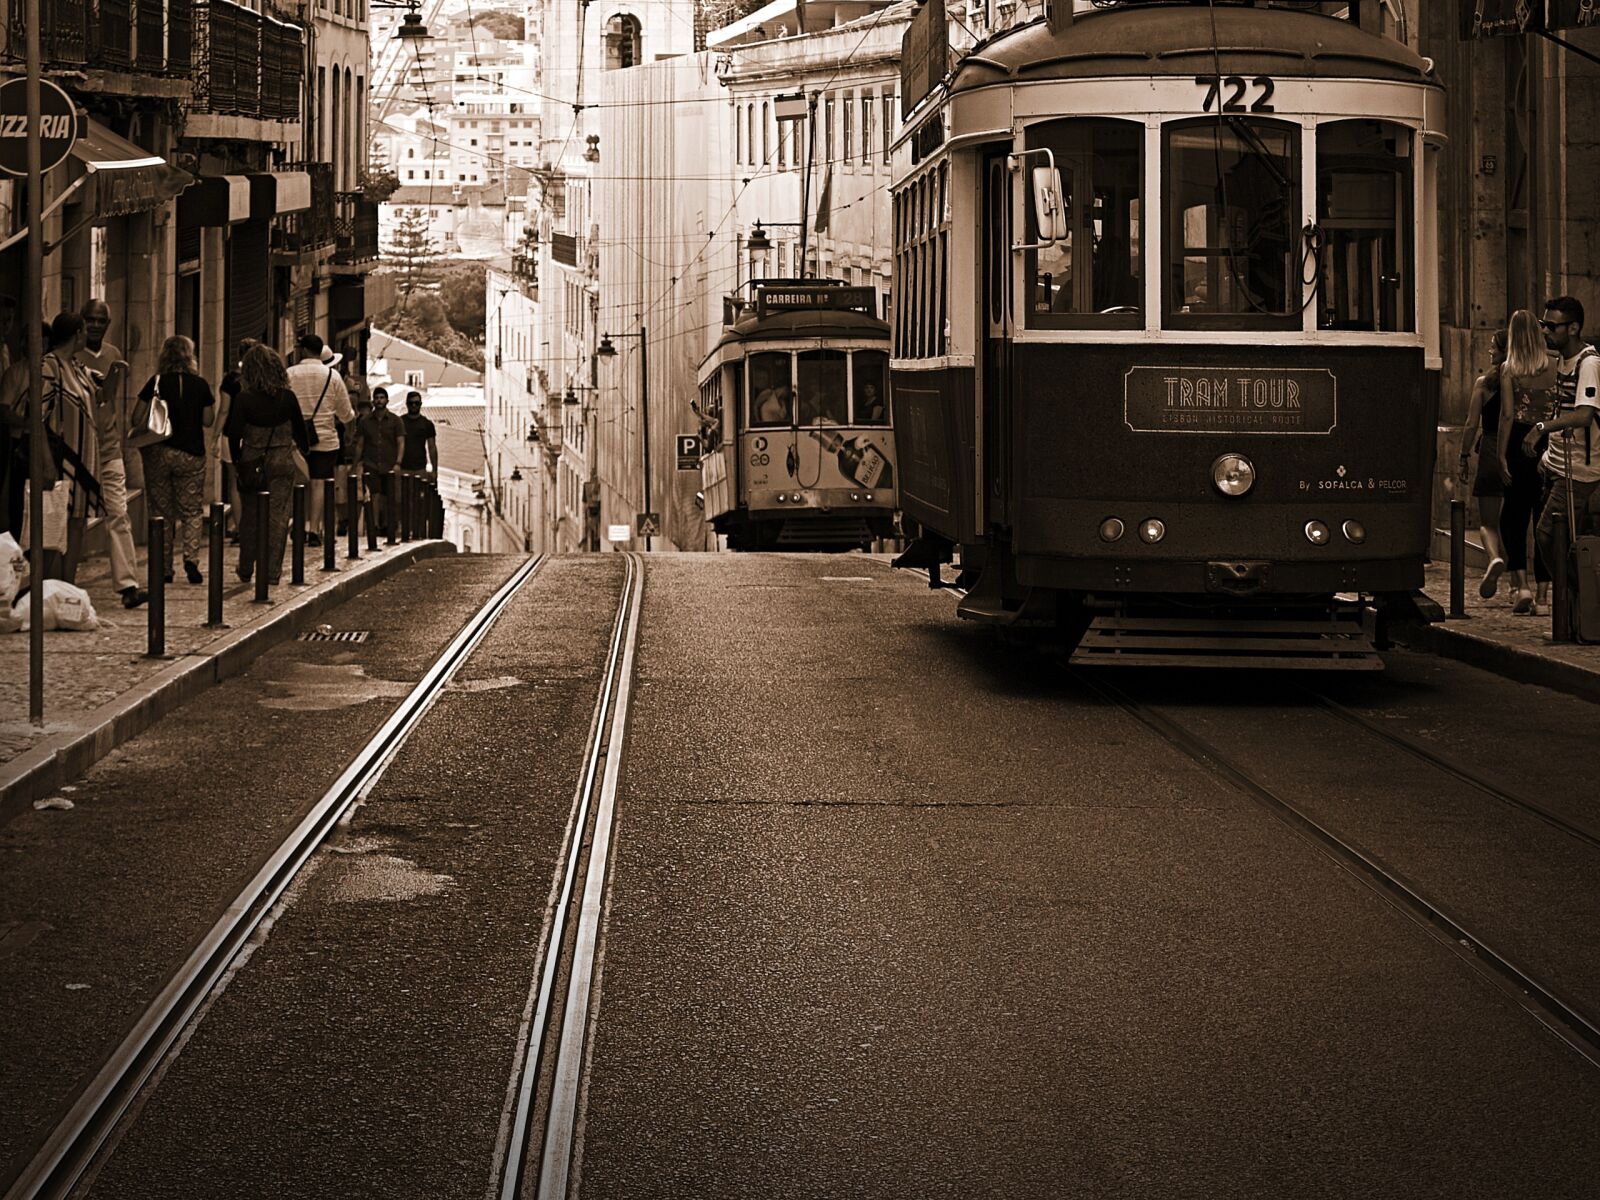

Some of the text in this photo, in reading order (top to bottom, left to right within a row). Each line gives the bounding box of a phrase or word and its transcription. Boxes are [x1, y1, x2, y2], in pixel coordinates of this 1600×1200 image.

[1195, 76, 1275, 113] 722
[0, 114, 70, 139] IZZRIA
[766, 294, 812, 304] CARREIRA
[1163, 377, 1301, 408] TRAM TOUR
[1162, 414, 1302, 425] LISBON HISTORICAL ROUTE
[683, 438, 696, 455] P
[1299, 478, 1407, 491] By SOFALCA & PELCOR
